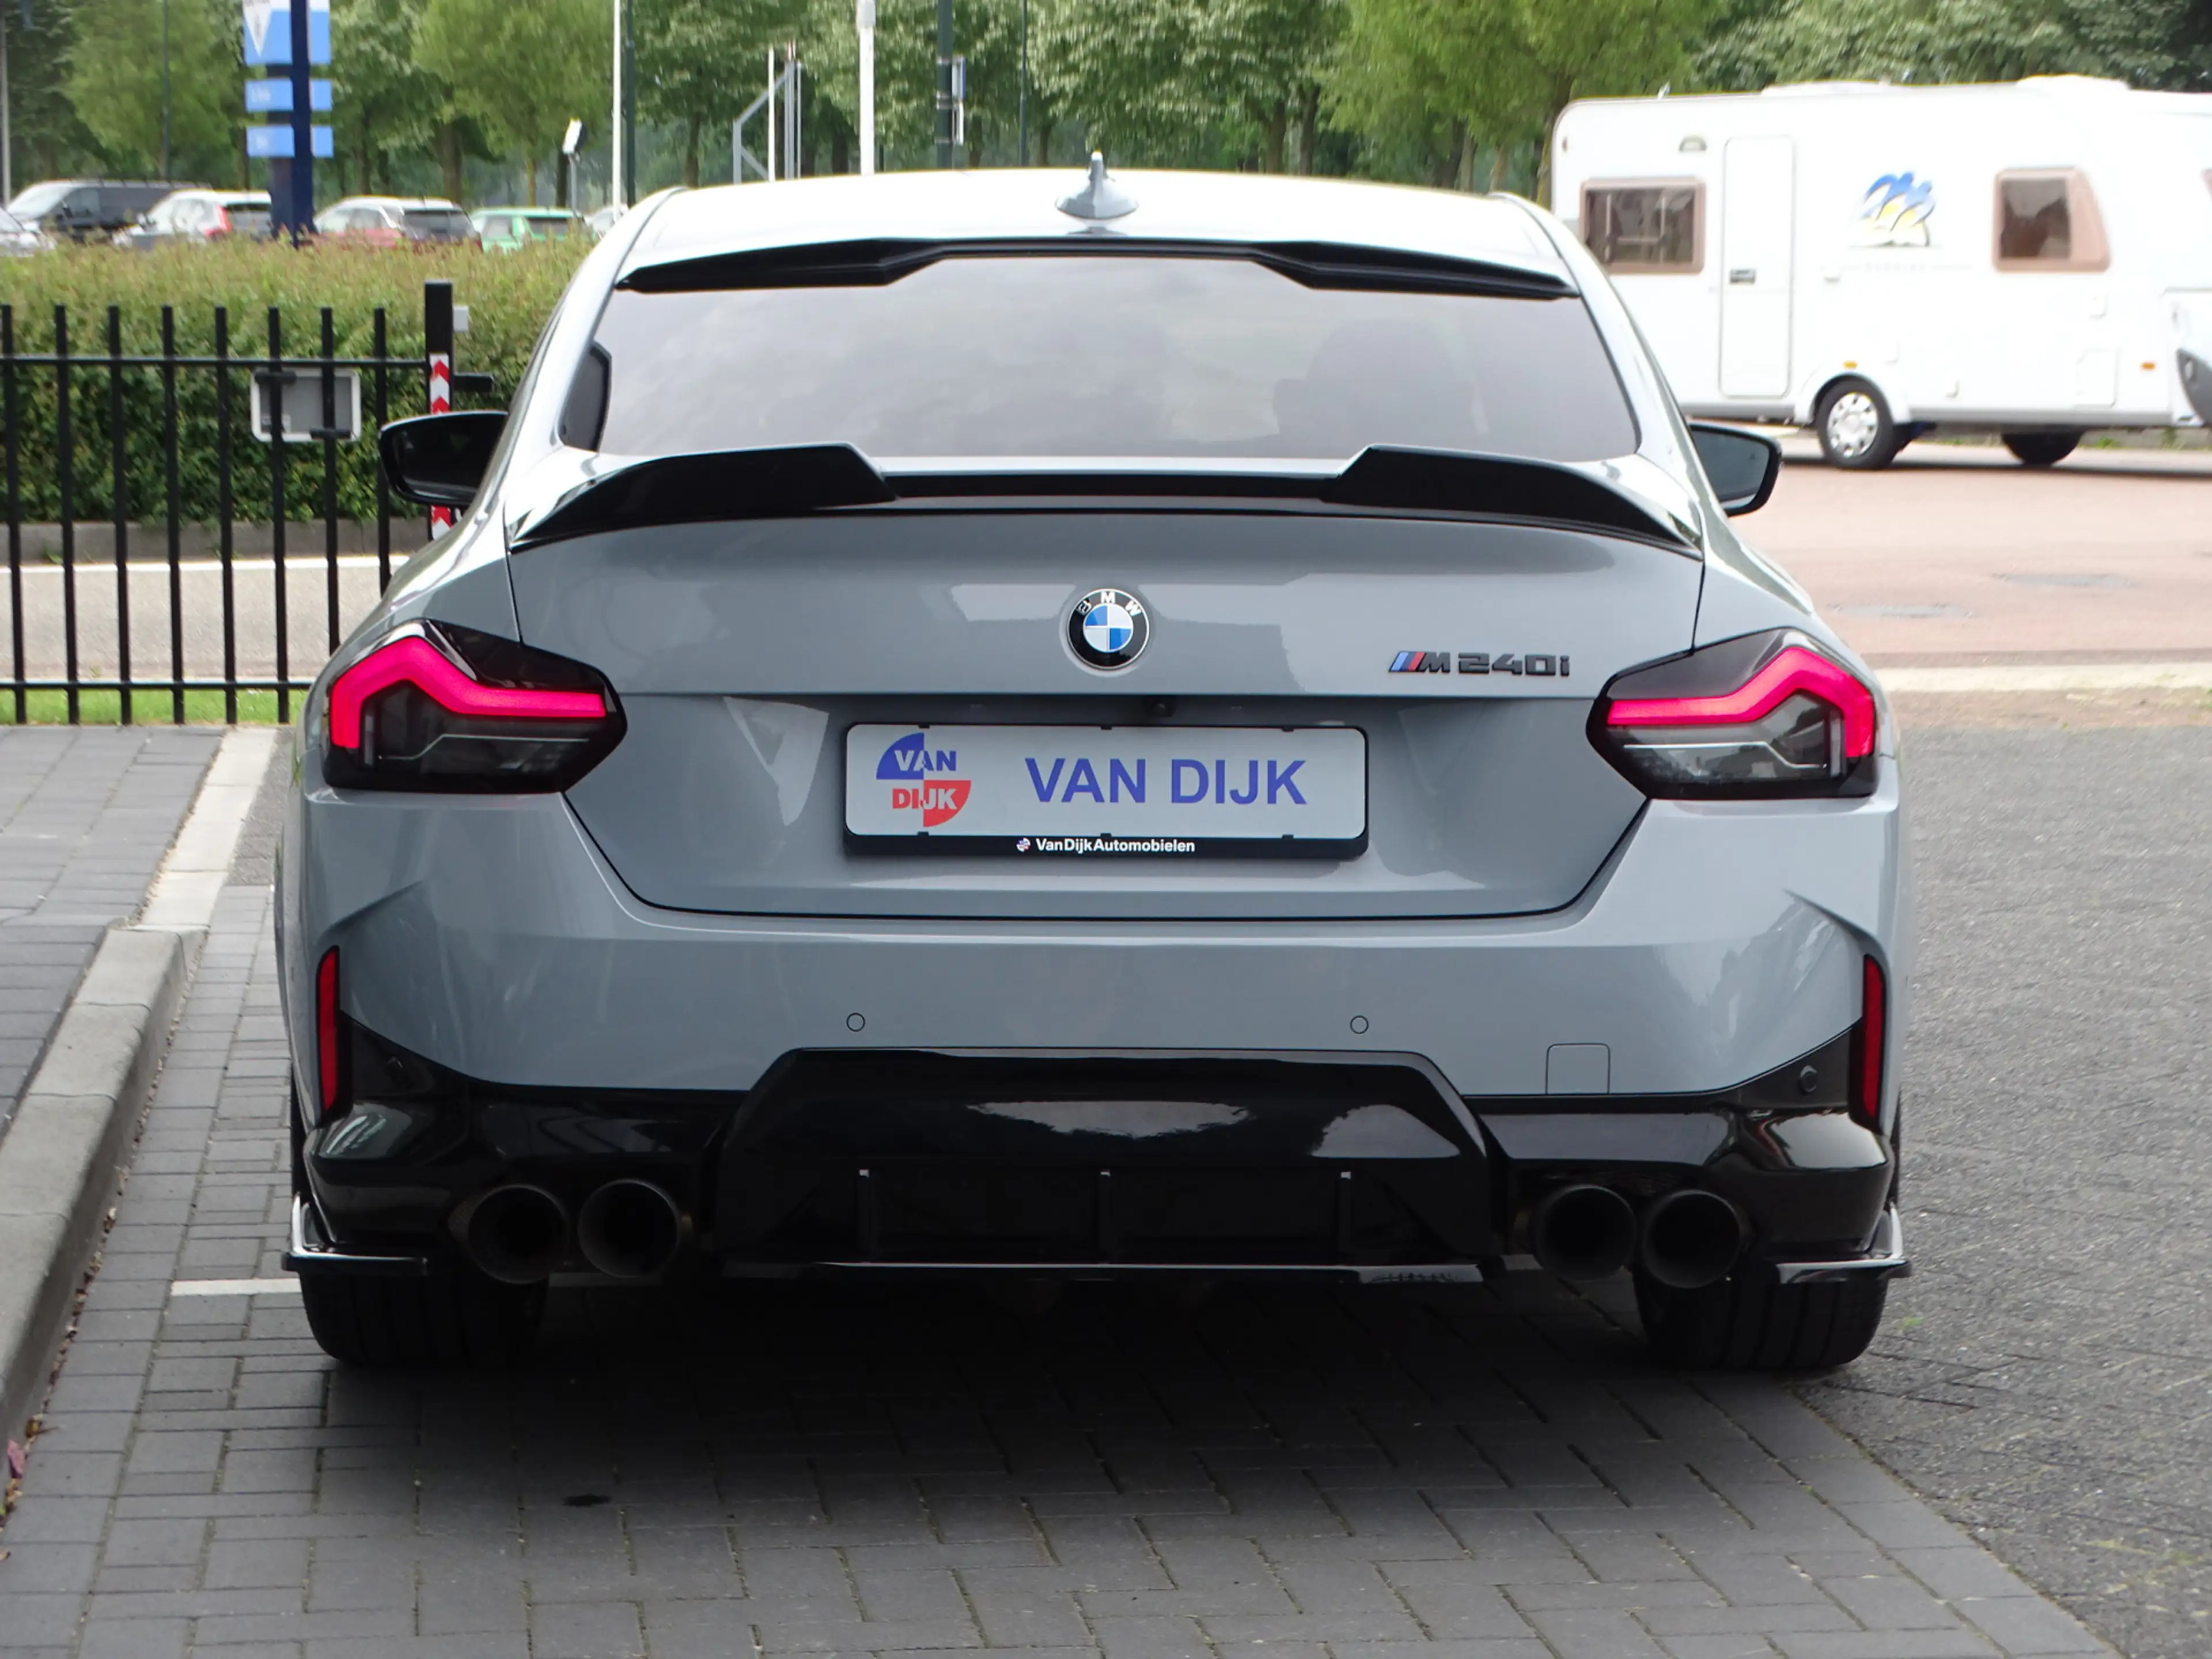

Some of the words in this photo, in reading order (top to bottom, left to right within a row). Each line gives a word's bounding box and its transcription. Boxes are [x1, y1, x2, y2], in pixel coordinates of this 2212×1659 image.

[1077, 591, 1142, 616] BMW
[893, 750, 957, 772] VAN
[1025, 757, 1146, 804] VAN
[1170, 759, 1307, 805] DIJK
[892, 788, 958, 810] DIJK
